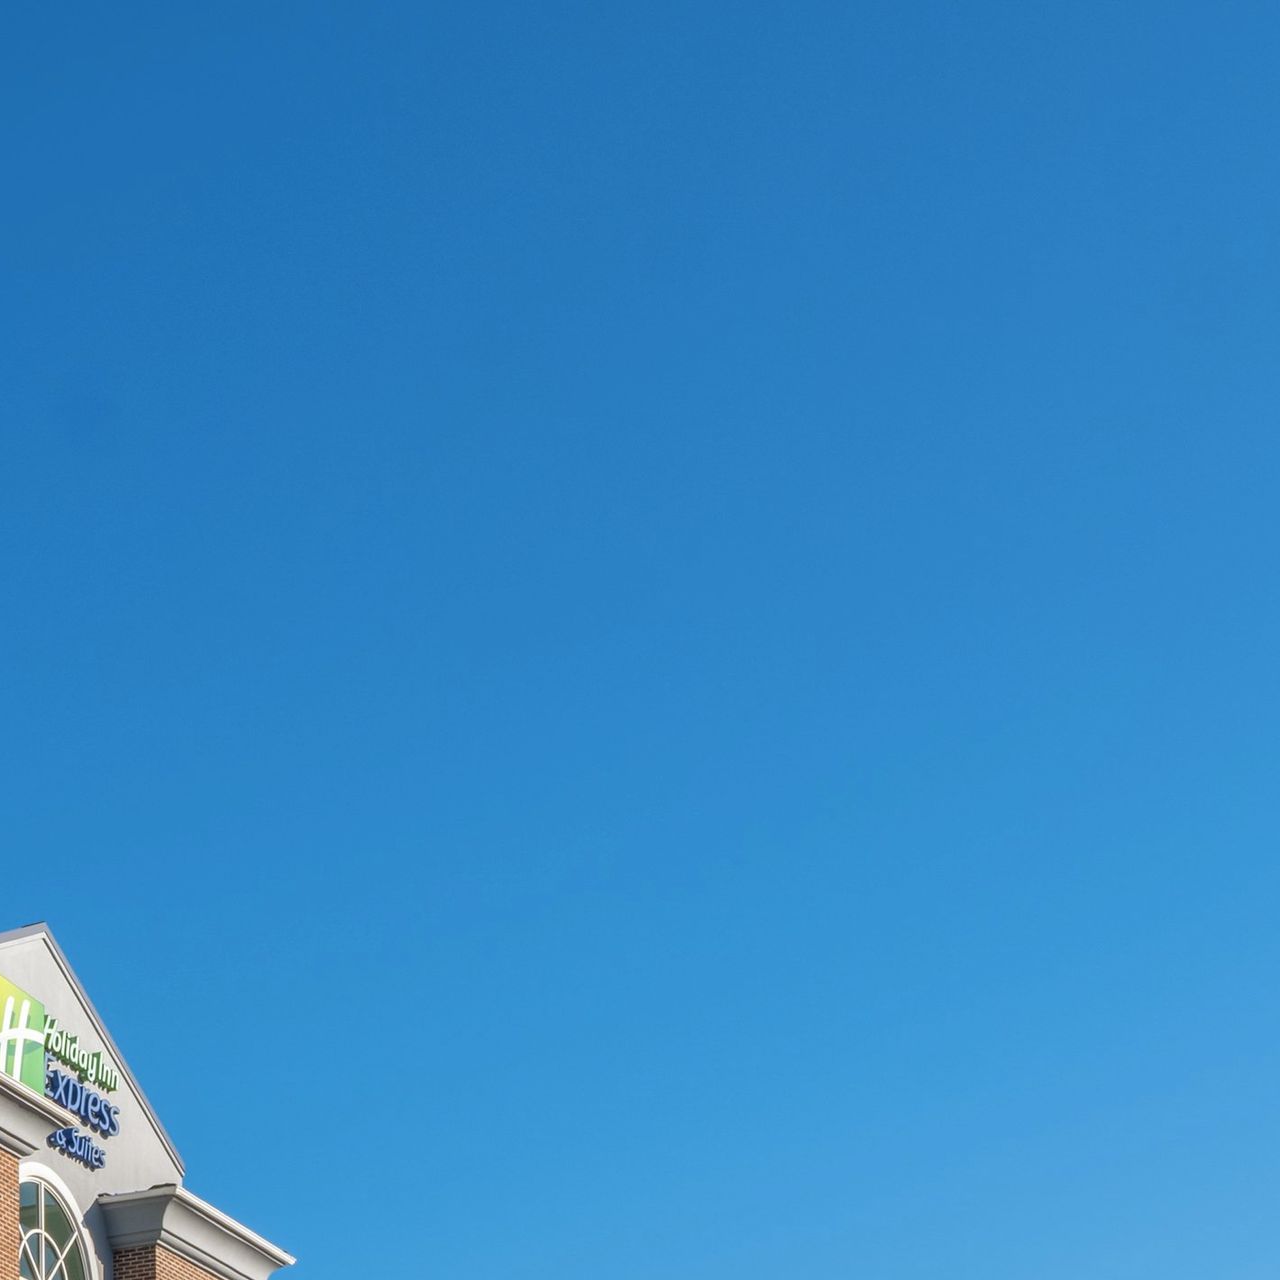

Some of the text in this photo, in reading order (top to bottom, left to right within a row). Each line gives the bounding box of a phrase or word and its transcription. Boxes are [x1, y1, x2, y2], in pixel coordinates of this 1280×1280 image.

[44, 1015, 120, 1090] Holiday Inn
[68, 1126, 106, 1169] Suites
